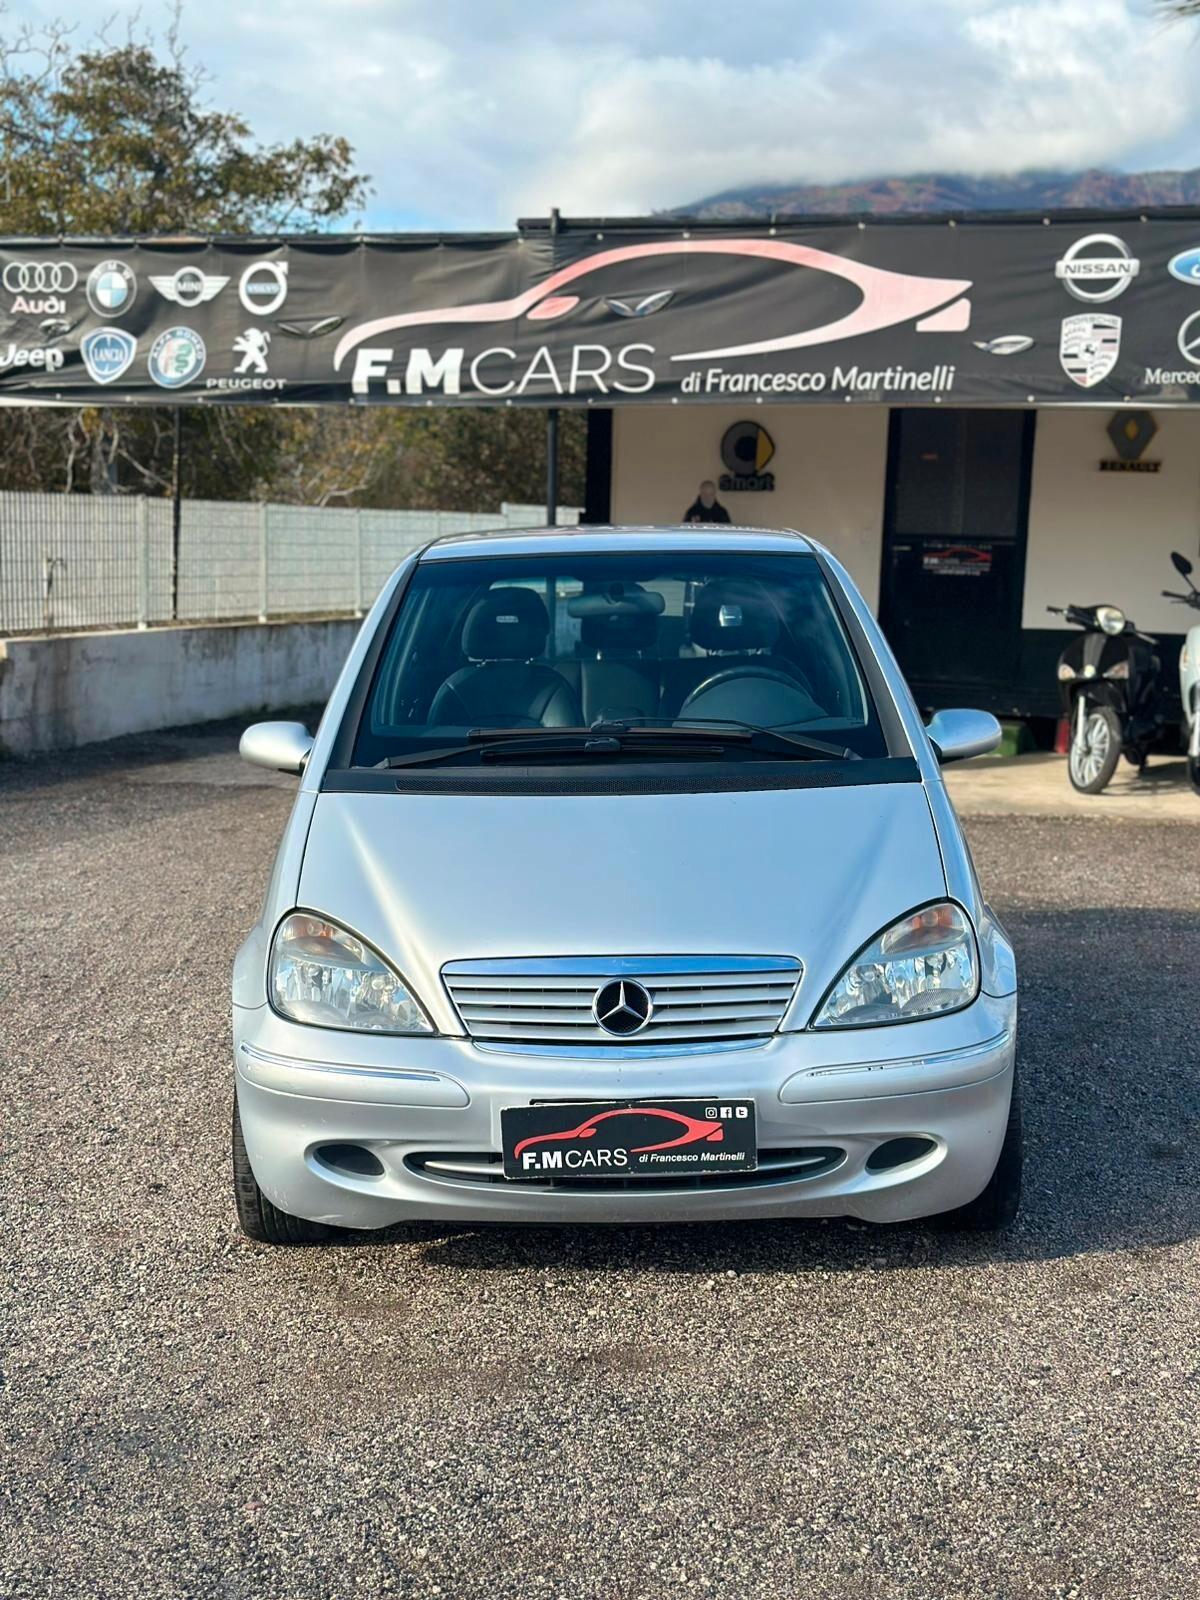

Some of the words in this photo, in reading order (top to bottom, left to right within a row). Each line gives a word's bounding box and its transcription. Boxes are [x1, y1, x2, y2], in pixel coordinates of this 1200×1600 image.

[1064, 263, 1131, 275] NISSAN
[178, 281, 202, 292] MINI
[10, 295, 66, 314] Audi
[0, 343, 64, 372] Jeep
[206, 378, 287, 390] PEUGEOT
[681, 371, 701, 393] di
[705, 368, 826, 393] Francesco
[831, 365, 956, 391] Martinelli
[639, 1153, 649, 1163] di
[650, 1153, 698, 1163] Francesco
[700, 1151, 746, 1162] Martinelli
